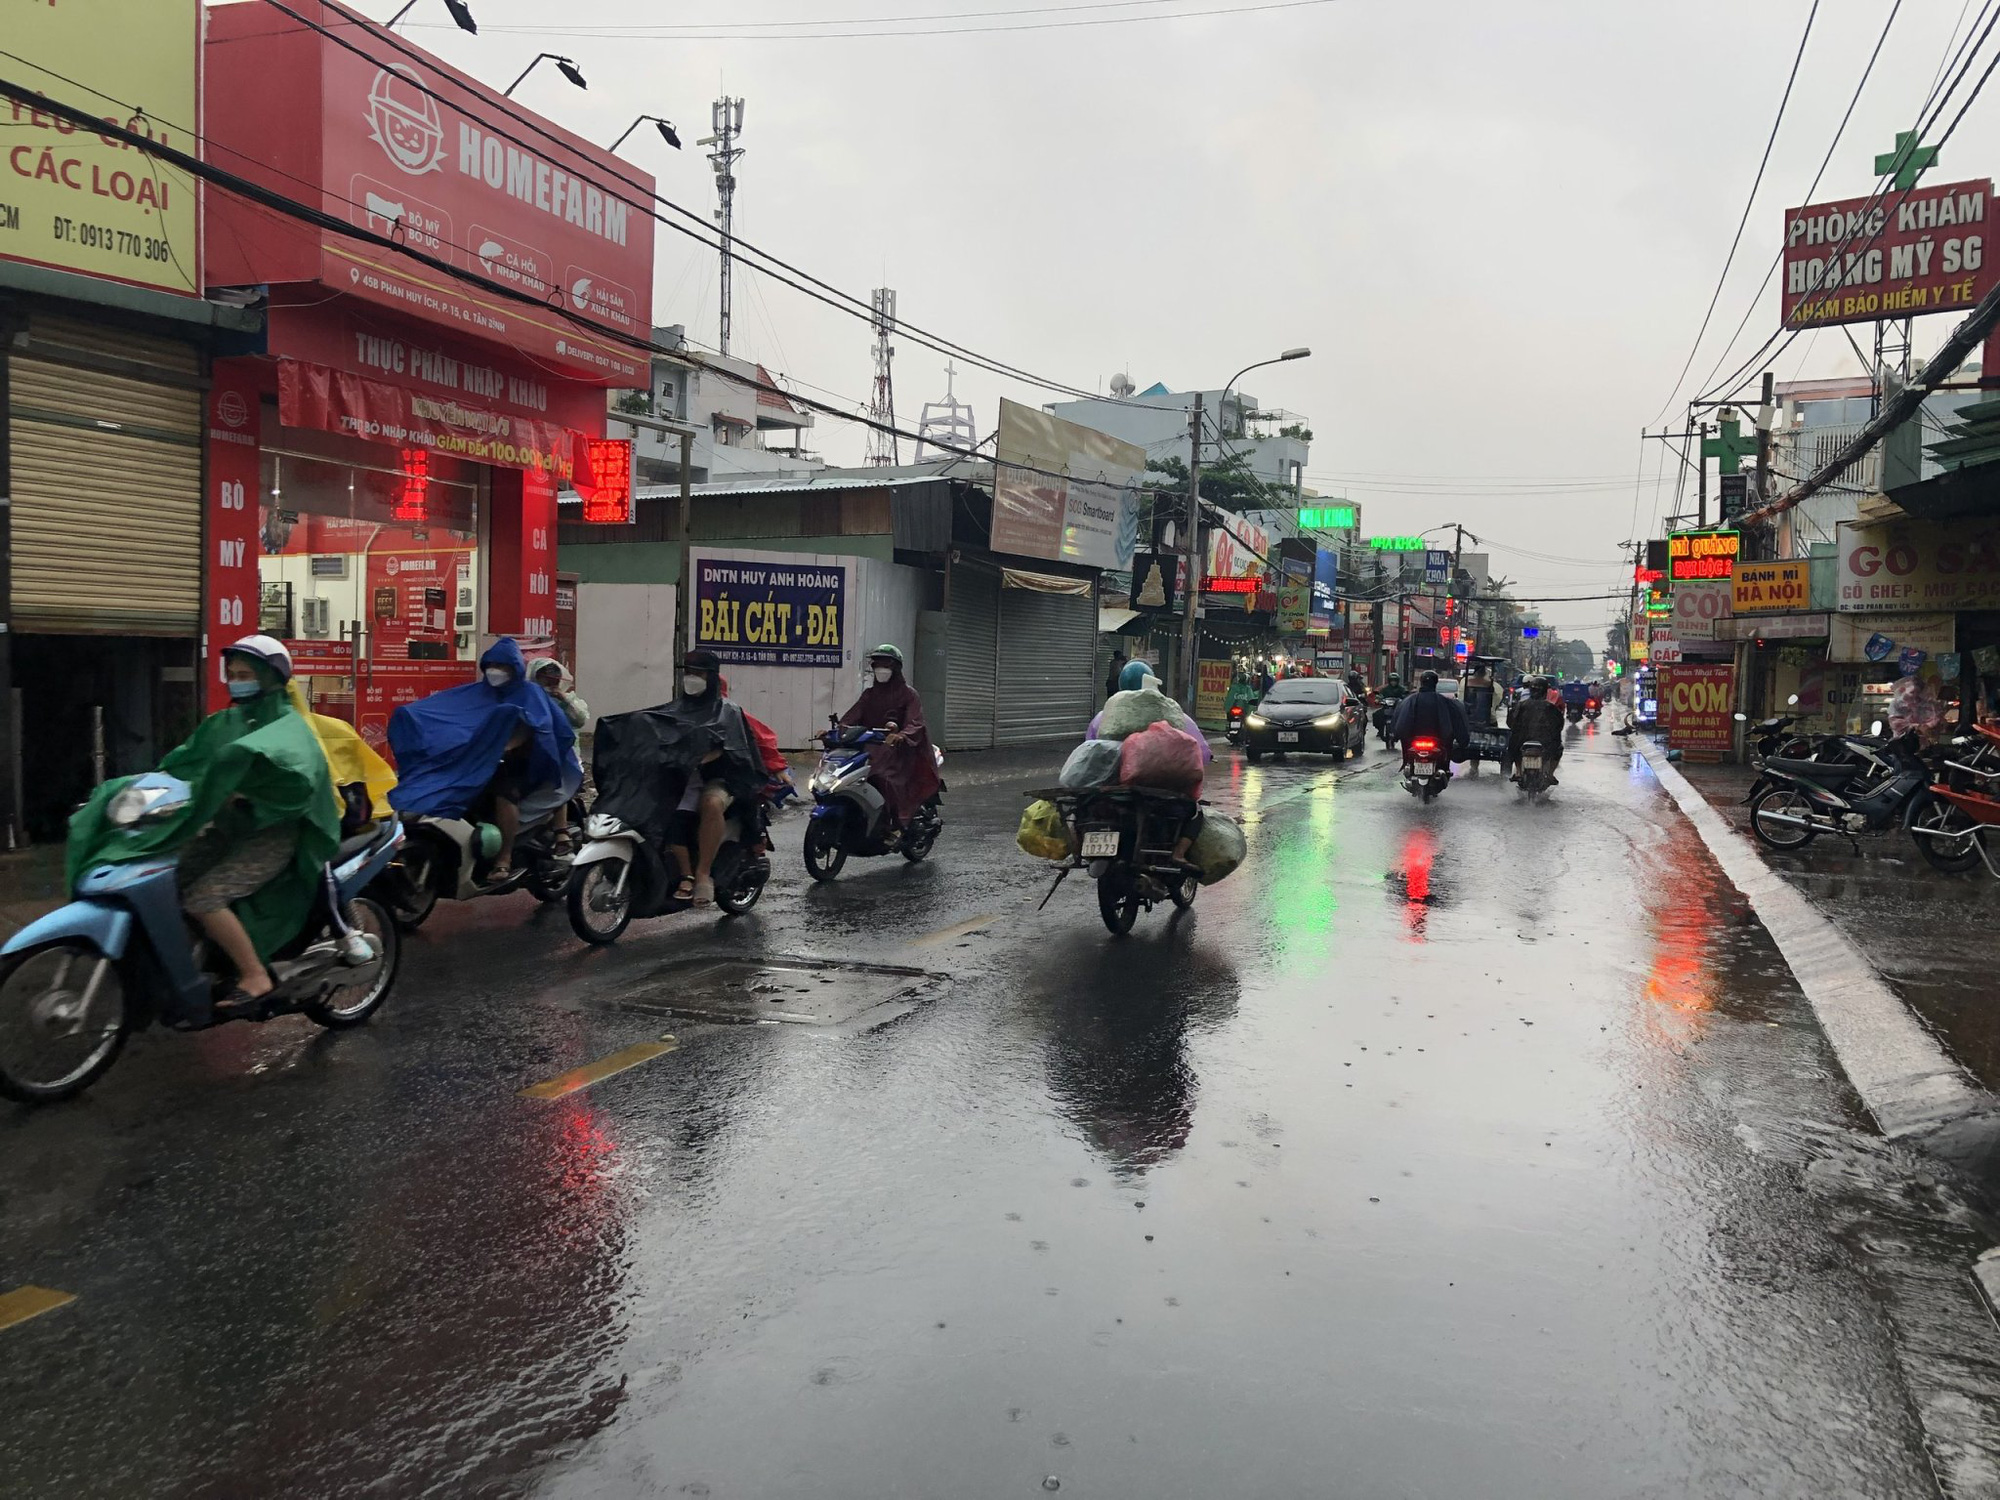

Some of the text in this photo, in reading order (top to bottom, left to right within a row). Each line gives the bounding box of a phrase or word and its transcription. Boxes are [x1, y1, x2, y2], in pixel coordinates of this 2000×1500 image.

[9, 146, 169, 214] CÁC LOẠI
[459, 121, 627, 246] HOMEFARM
[408, 211, 440, 234] BÒ MỸ
[1789, 189, 1984, 247] PHÒNG KHÁM
[54, 215, 77, 242] ĐT:
[80, 223, 113, 250] 0913
[117, 231, 141, 256] 770
[145, 238, 168, 262] 306
[506, 252, 519, 268] CÁ
[1788, 235, 1982, 295] HOÀNG MỸ SG
[381, 280, 404, 298] PHAN
[406, 289, 422, 304] HUY
[1792, 275, 1977, 323] KHÁM BẢO HIỂM Y TẾ
[356, 332, 404, 375] THỰC
[464, 364, 504, 402] NHẬP
[364, 418, 380, 435] BÒ
[382, 424, 407, 443] NHẬP
[221, 479, 244, 510] BÒ
[1068, 499, 1115, 522] SCG Smartboard
[533, 527, 547, 550] CÁ
[1371, 537, 1423, 550] NHA KHOA
[1671, 534, 1737, 559] MÌ QUẢNG
[220, 537, 246, 568] MỸ
[1429, 551, 1445, 565] NHA
[704, 568, 839, 588] DNTN HUY ANH HOÀNG
[1426, 569, 1446, 583] KHOA
[1698, 557, 1723, 578] LỘC
[1742, 565, 1799, 582] BÁNH MÌ
[1736, 581, 1802, 603] HÀ NỘI
[1842, 581, 1863, 599] GỖ
[220, 595, 243, 626] BÒ
[700, 590, 839, 645] BÃI CÁT ĐÁ
[1635, 627, 1645, 640] XE
[1200, 661, 1231, 679] BÁNH
[1203, 680, 1226, 692] KEM
[1672, 677, 1728, 713] CƠM
[1693, 729, 1716, 738] CÔNG
[1719, 729, 1728, 738] TY
